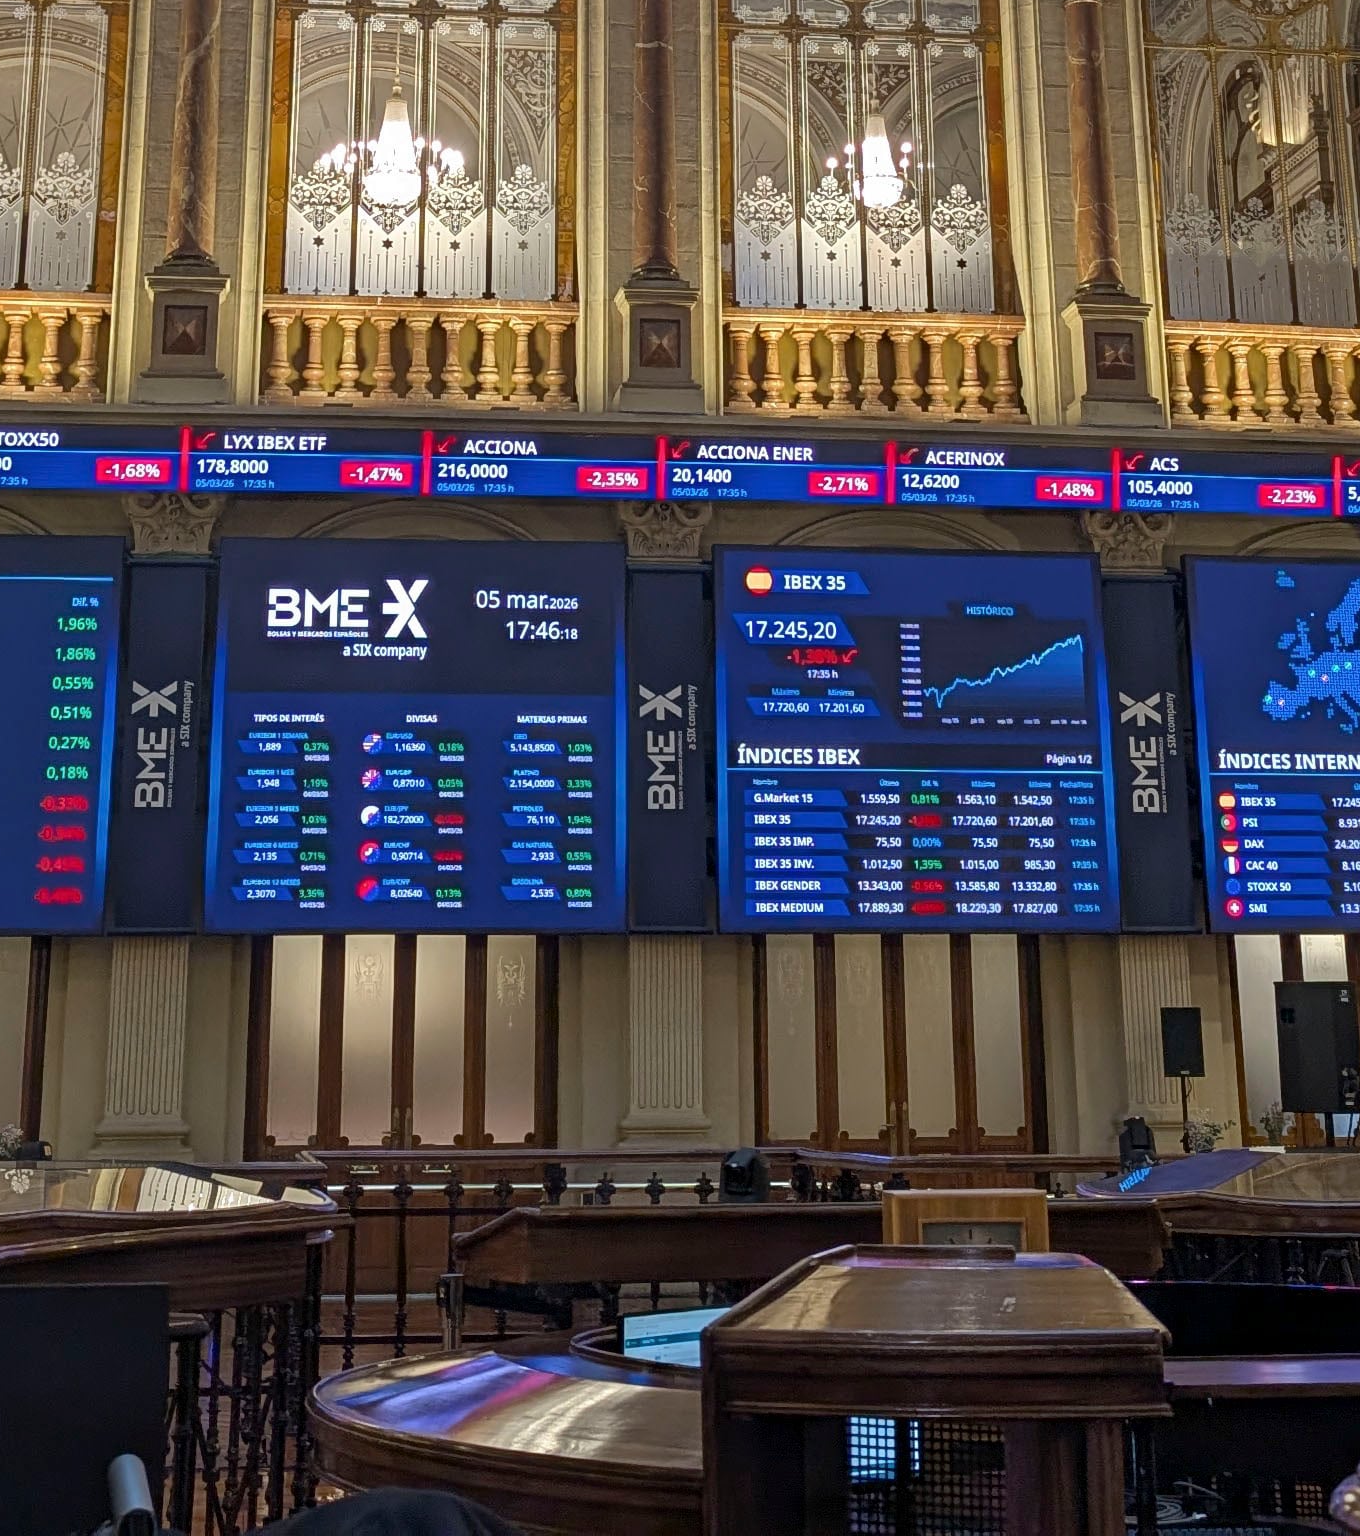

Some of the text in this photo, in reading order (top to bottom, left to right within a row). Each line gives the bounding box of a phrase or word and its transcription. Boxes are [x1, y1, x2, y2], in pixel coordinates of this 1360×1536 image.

[224, 435, 326, 450] LYX IBEX ETF
[461, 440, 537, 458] ACCIONA
[697, 445, 813, 461] ACCIONA ENER
[926, 451, 1004, 466] ACERINOX
[106, 464, 160, 479] -1,68%
[198, 459, 402, 482] 178,8000 -1,47%
[1150, 458, 1178, 471] ACS
[438, 464, 638, 487] 216,0000 -2,35%
[673, 468, 868, 492] 20,1400 -2,71%
[903, 474, 1094, 497] 12,6200 -1,48%
[1128, 480, 1316, 504] 105,4000 -2,23%
[784, 575, 845, 590] IBEX 35
[476, 590, 500, 608] 05
[967, 605, 1013, 616] HISTÓRICO
[58, 618, 97, 631] 1,96%
[746, 621, 836, 641] 17.245,20
[56, 648, 95, 661] 1,86%
[343, 644, 427, 660] a SIX company
[53, 677, 93, 690] 0,55%
[51, 706, 92, 720] 0,51%
[764, 703, 864, 713] 17.720,60 17.201,60
[254, 713, 324, 722] TIPOS DE INTERÉS
[49, 737, 90, 750] 0,27%
[738, 744, 860, 765] ÍNDICES IBEX
[1047, 754, 1092, 766] Página 1/2
[1219, 749, 1291, 769] ÍNDICES
[47, 766, 88, 780] 0,18%
[1241, 797, 1276, 806] IBEX 35
[1243, 818, 1258, 827] PSI
[1245, 840, 1264, 848] DAX
[1246, 861, 1278, 870] CAC 40
[1248, 882, 1291, 891] STOXX 50
[1249, 904, 1267, 912] SMI
